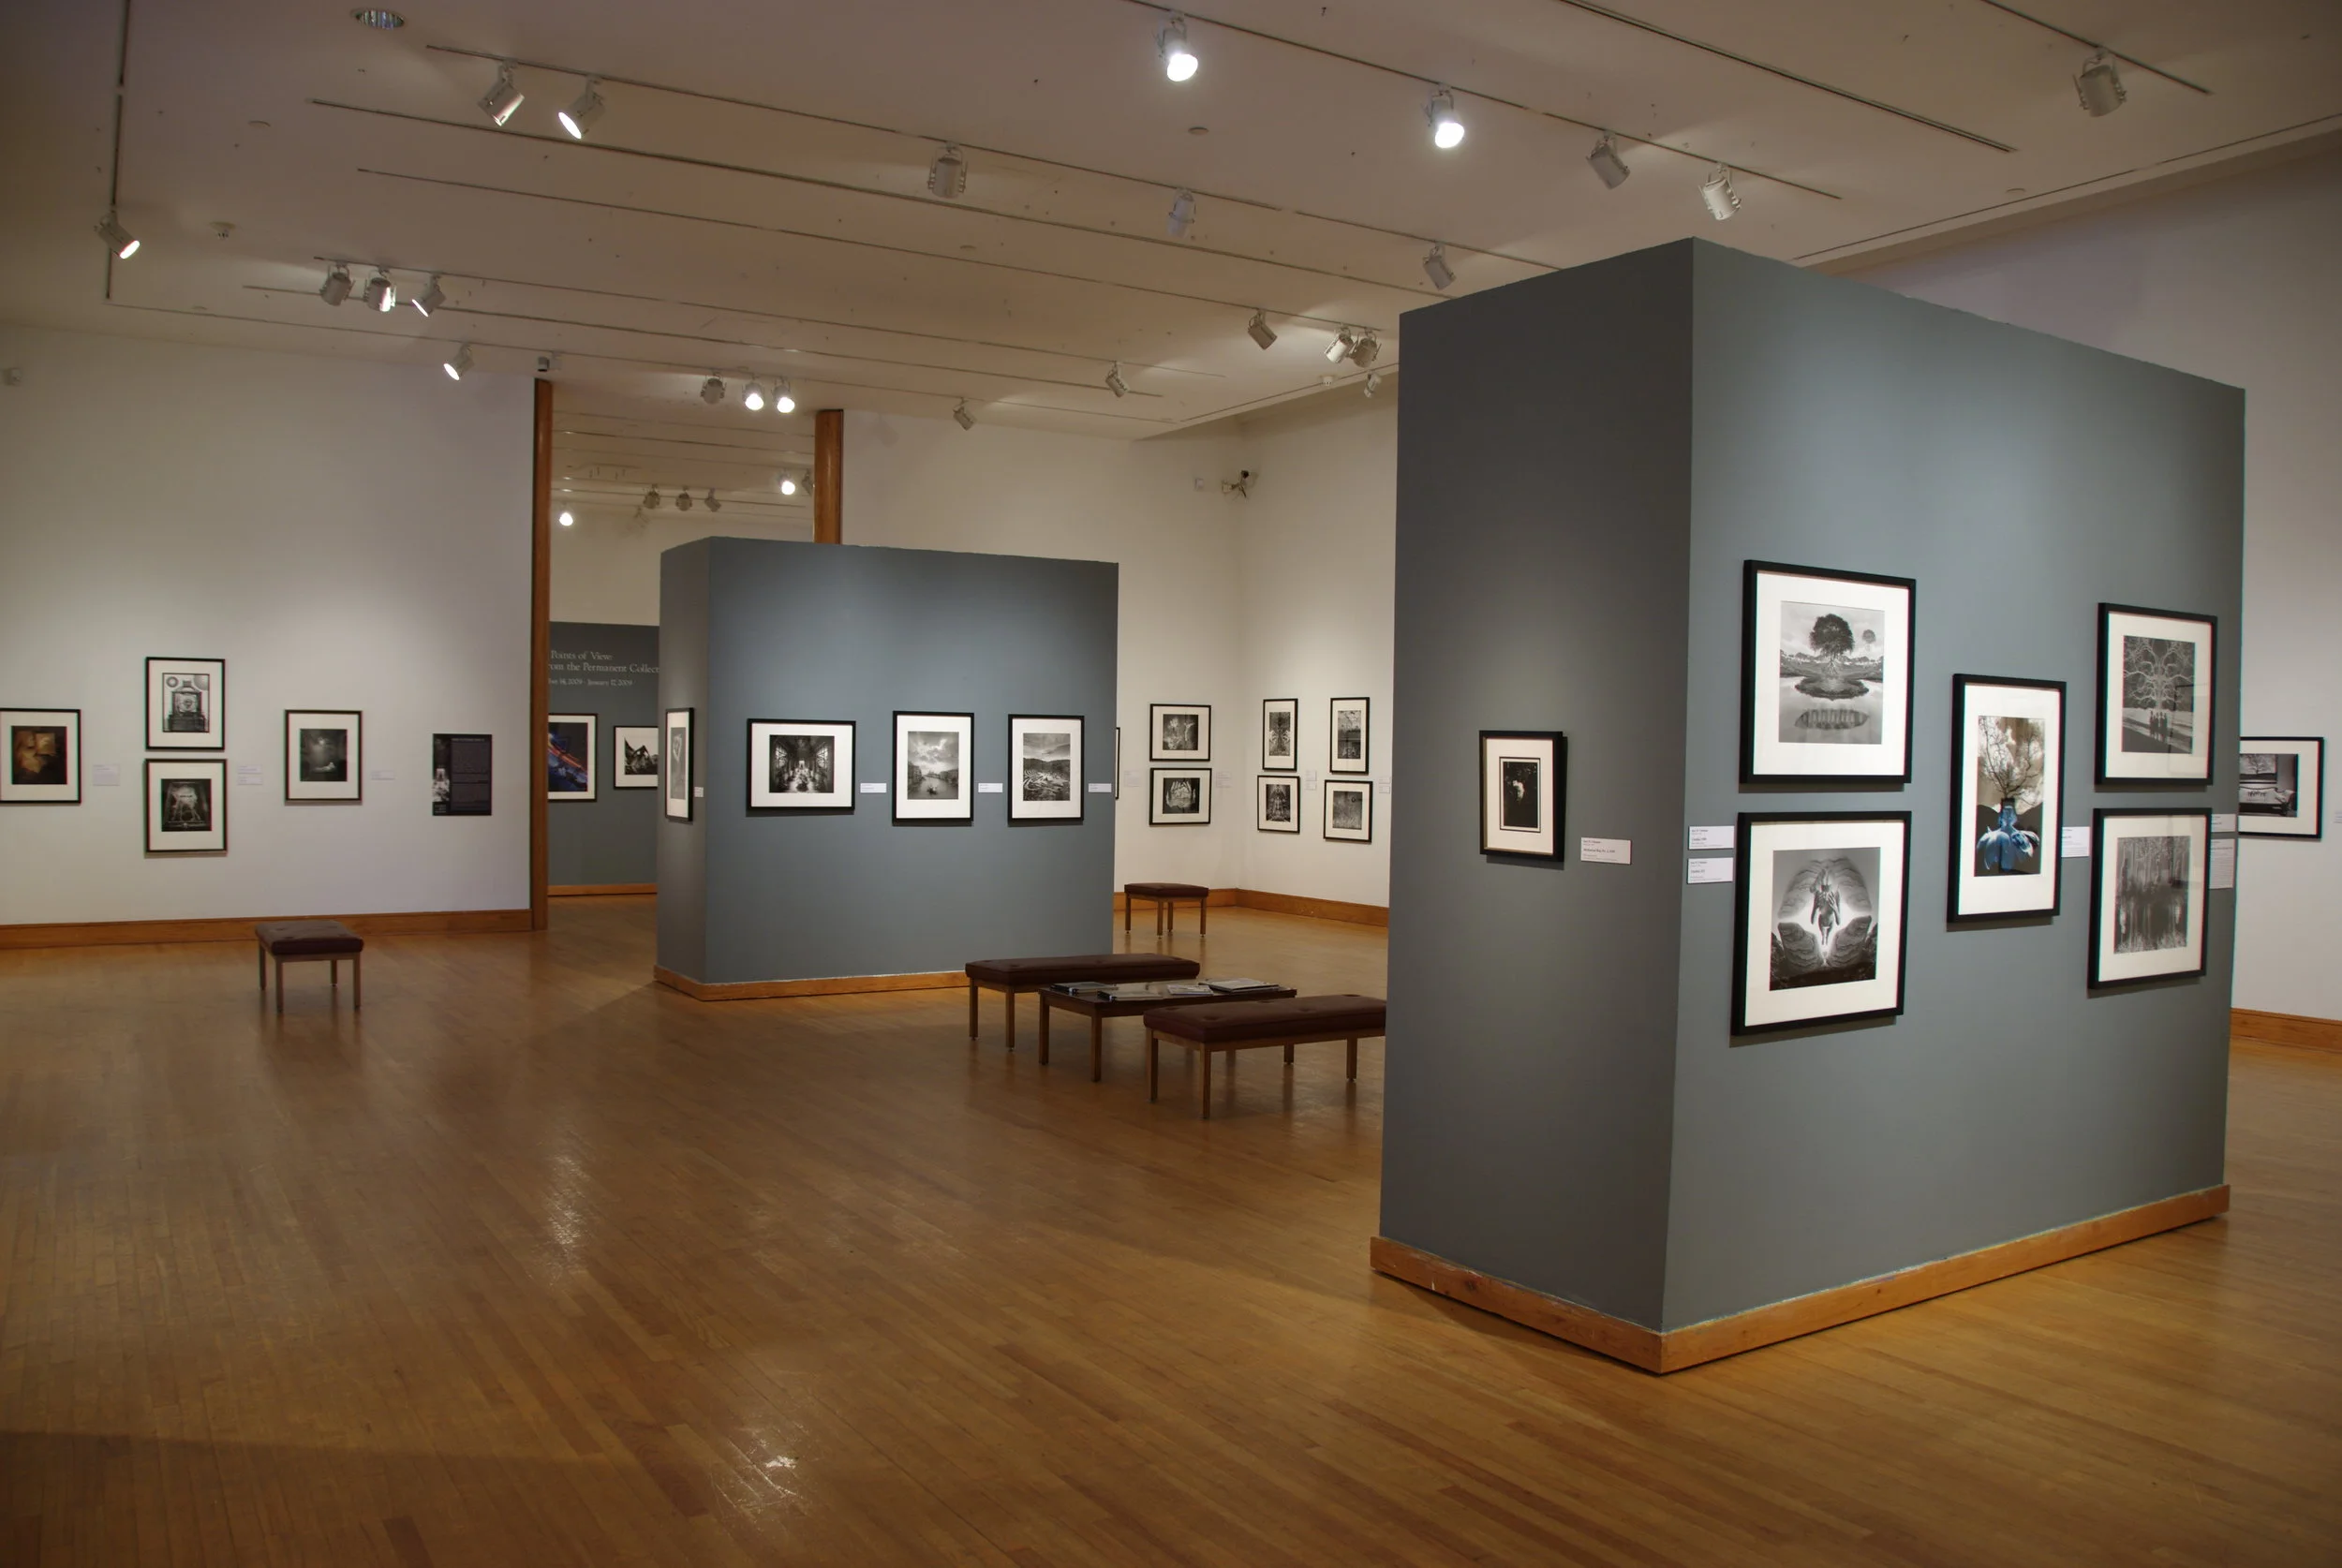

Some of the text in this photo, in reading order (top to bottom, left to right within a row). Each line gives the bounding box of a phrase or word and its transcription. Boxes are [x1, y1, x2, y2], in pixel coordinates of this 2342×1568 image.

[551, 650, 576, 659] Points
[578, 650, 588, 659] of
[566, 661, 580, 672] the
[583, 661, 628, 673] Permanent
